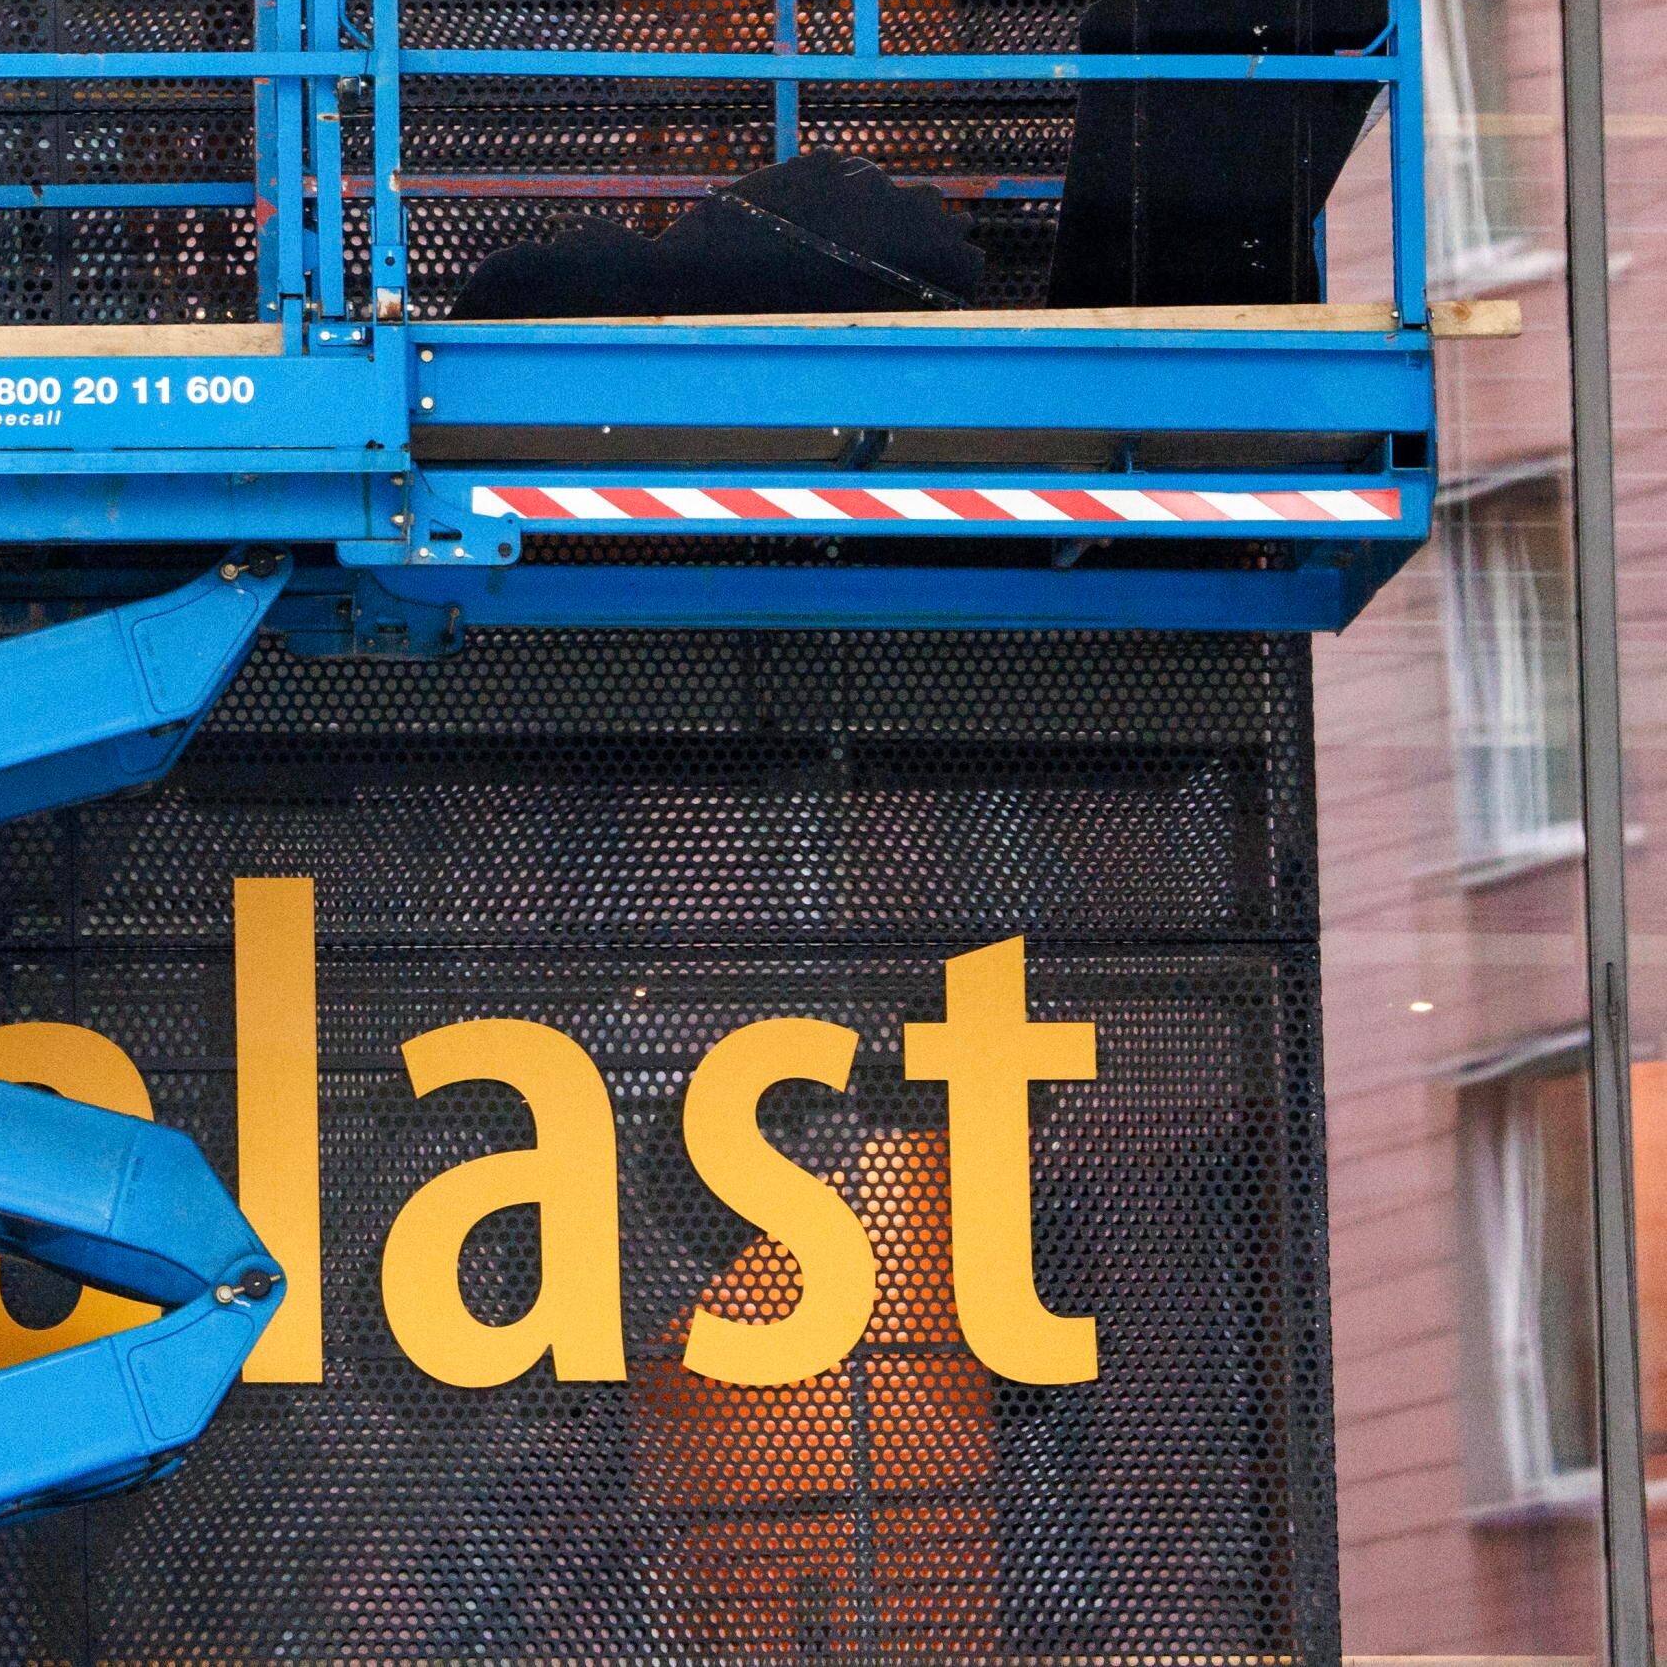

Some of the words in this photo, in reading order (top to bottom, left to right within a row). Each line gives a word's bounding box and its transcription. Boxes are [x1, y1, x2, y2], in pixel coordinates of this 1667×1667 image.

[73, 376, 118, 404] 20
[132, 376, 171, 404] 11
[185, 375, 256, 404] 600
